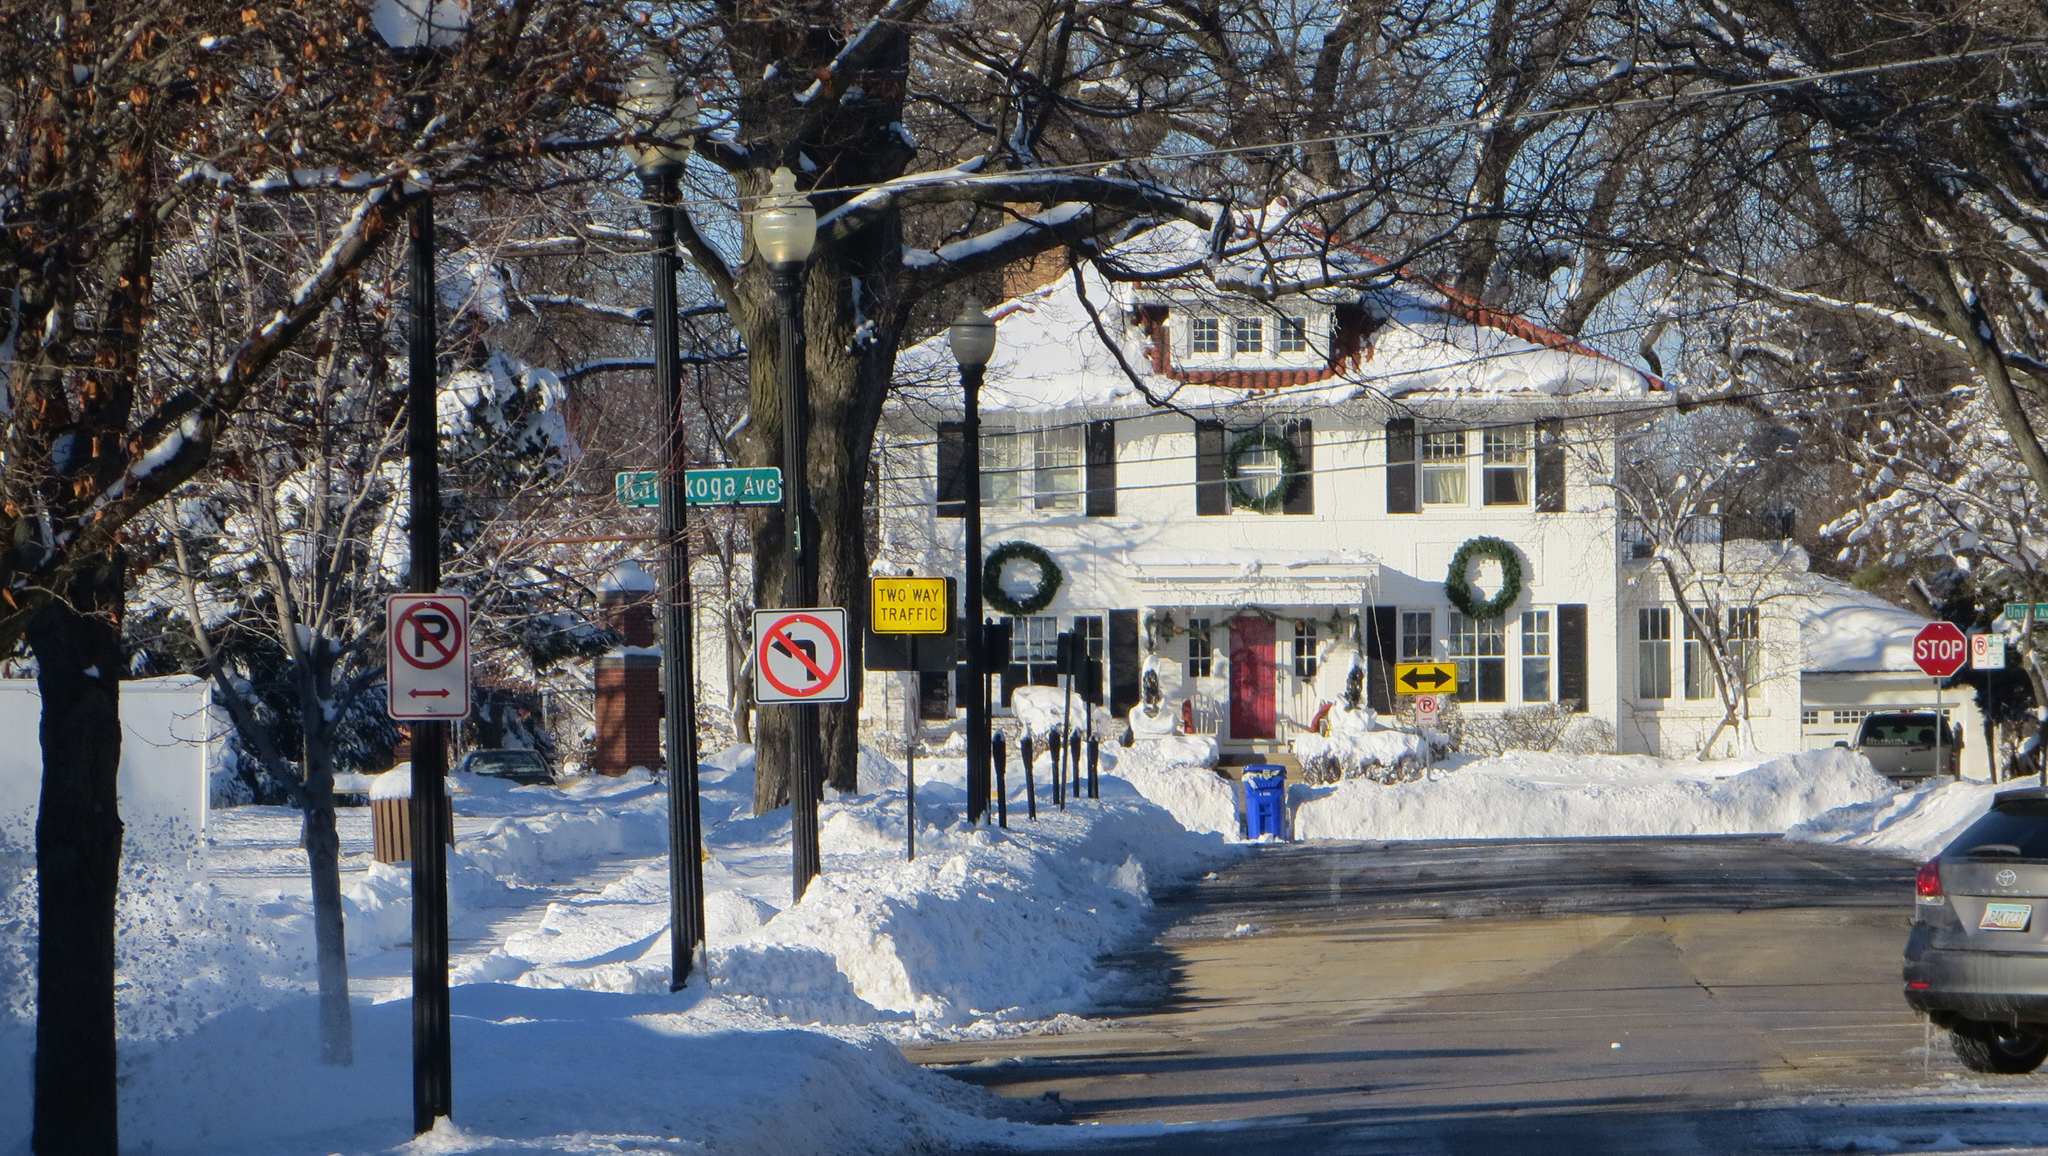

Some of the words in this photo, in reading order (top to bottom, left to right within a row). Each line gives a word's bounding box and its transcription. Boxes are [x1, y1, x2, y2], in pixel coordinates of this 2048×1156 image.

[743, 476, 776, 496] Ave
[879, 588, 907, 602] TWO
[912, 588, 939, 602] WAY
[880, 607, 938, 621] TRAFFIC
[1916, 639, 1963, 660] STOP
